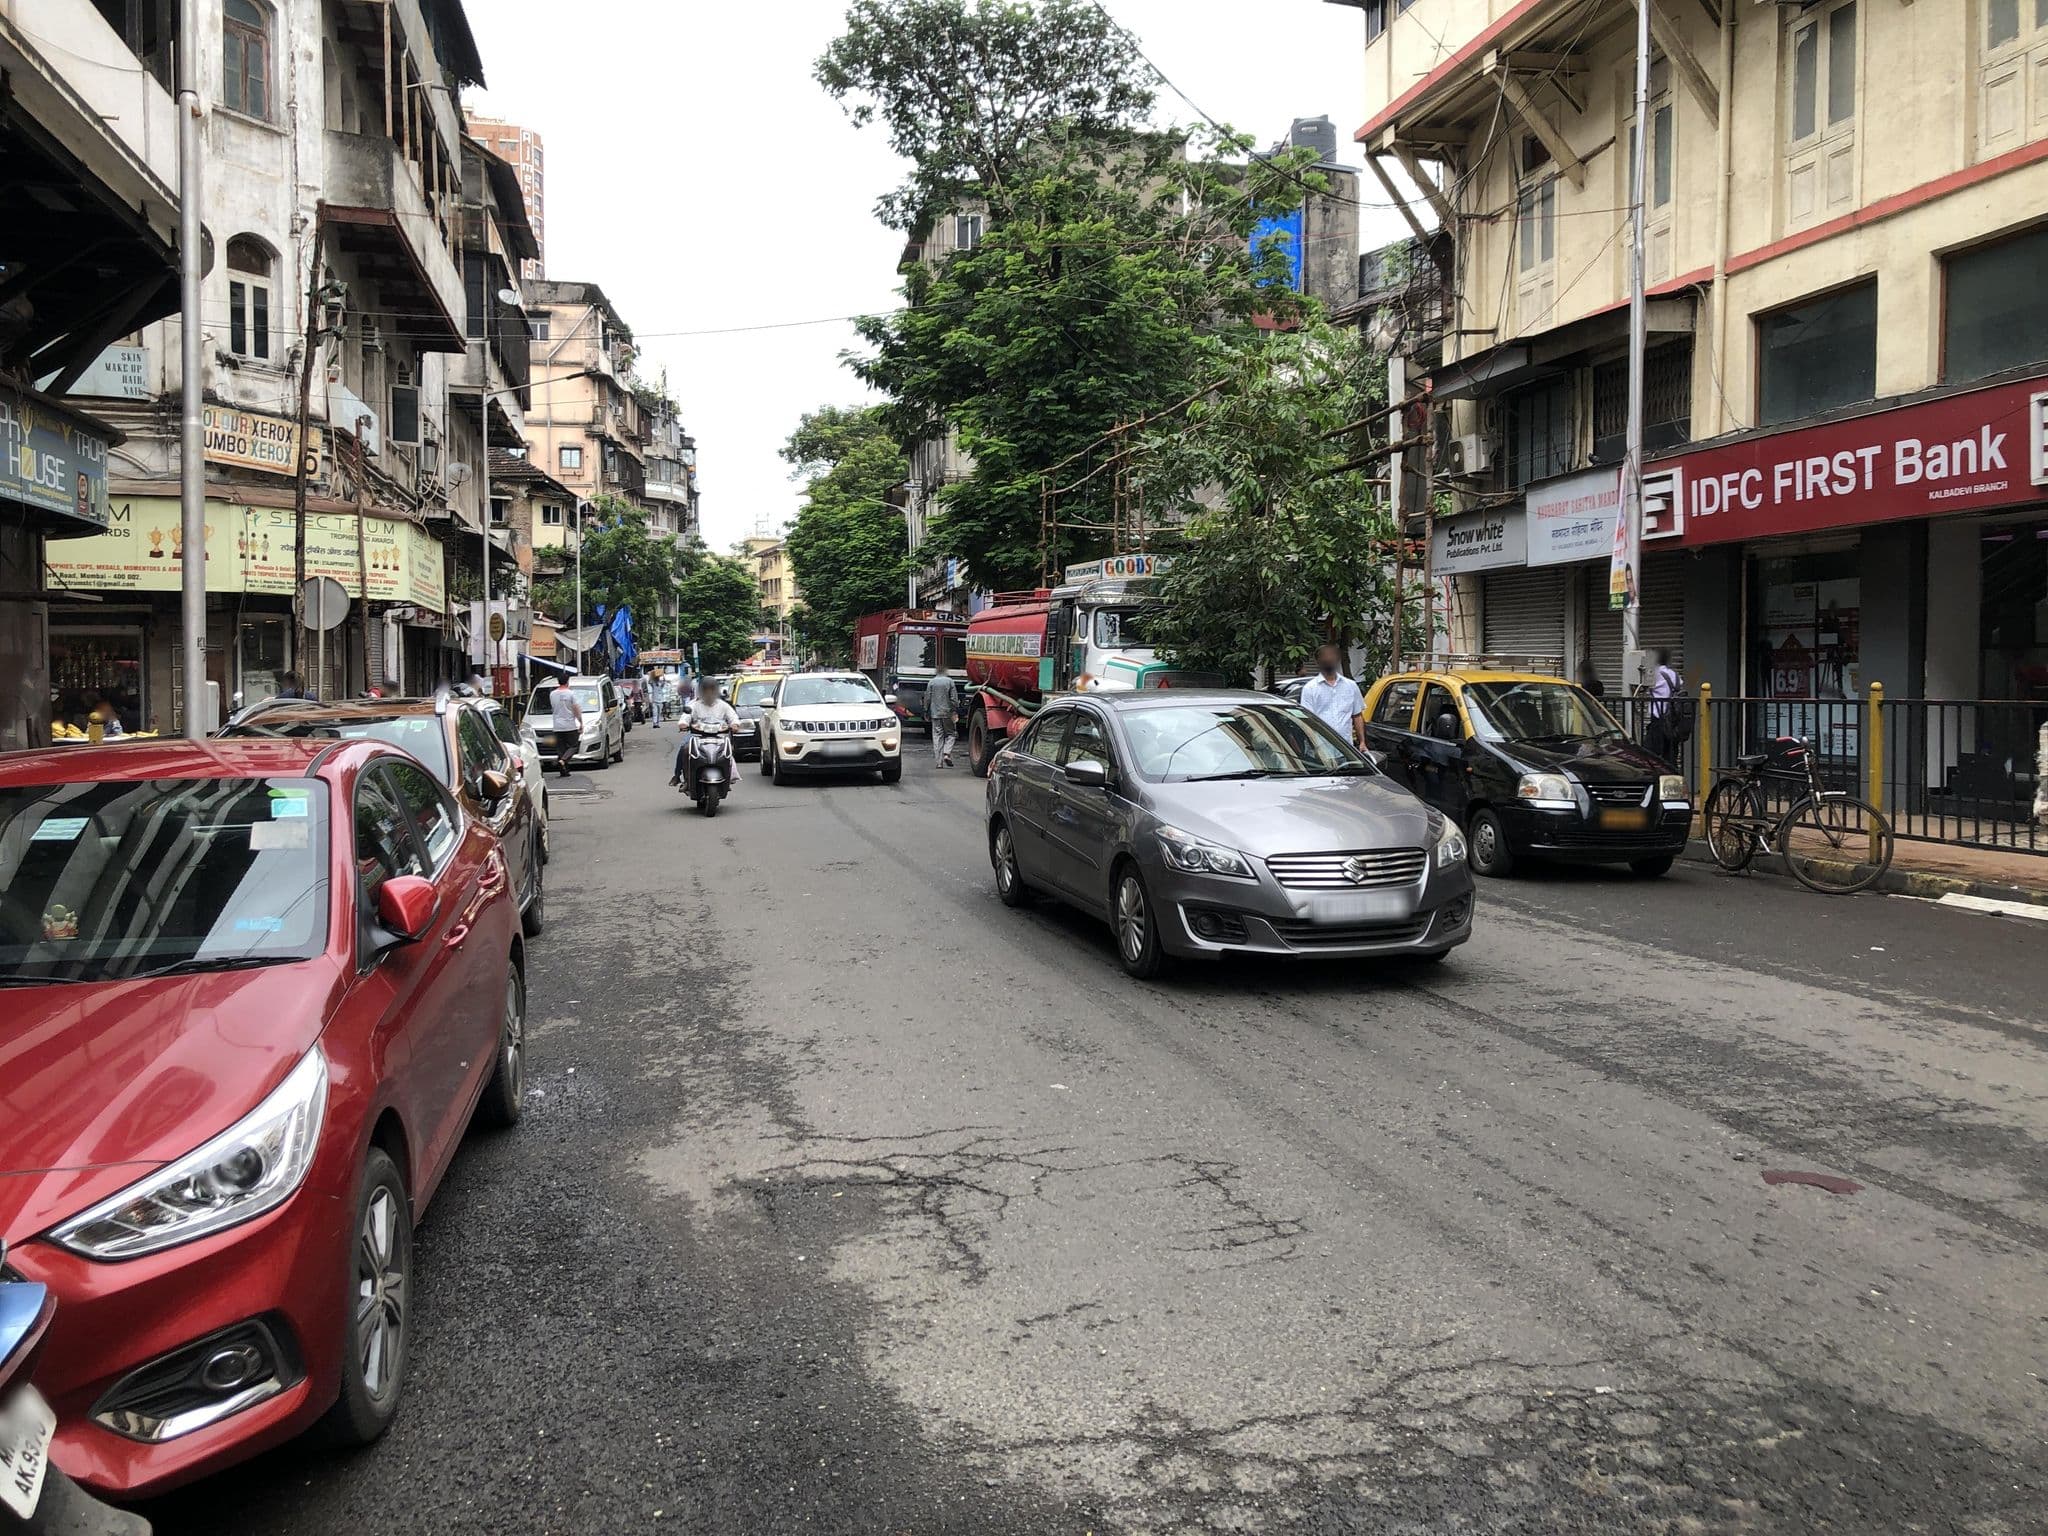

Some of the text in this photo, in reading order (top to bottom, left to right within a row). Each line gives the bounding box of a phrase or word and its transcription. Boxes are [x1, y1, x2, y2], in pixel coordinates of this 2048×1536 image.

[121, 352, 142, 363] SKIN
[105, 362, 143, 374] MAKE UP
[203, 409, 294, 444] OLOUR XEROX
[203, 430, 292, 465] UMBO XEROX
[1691, 424, 2008, 517] IDFC FIRST Bank
[1928, 480, 2009, 500] KALBADEVI BRANCH
[371, 536, 395, 545] AWARDS
[1446, 519, 1504, 547] Snow white
[1446, 546, 1480, 559] Publications
[1104, 555, 1152, 576] GOODS
[937, 611, 963, 621] GAS
